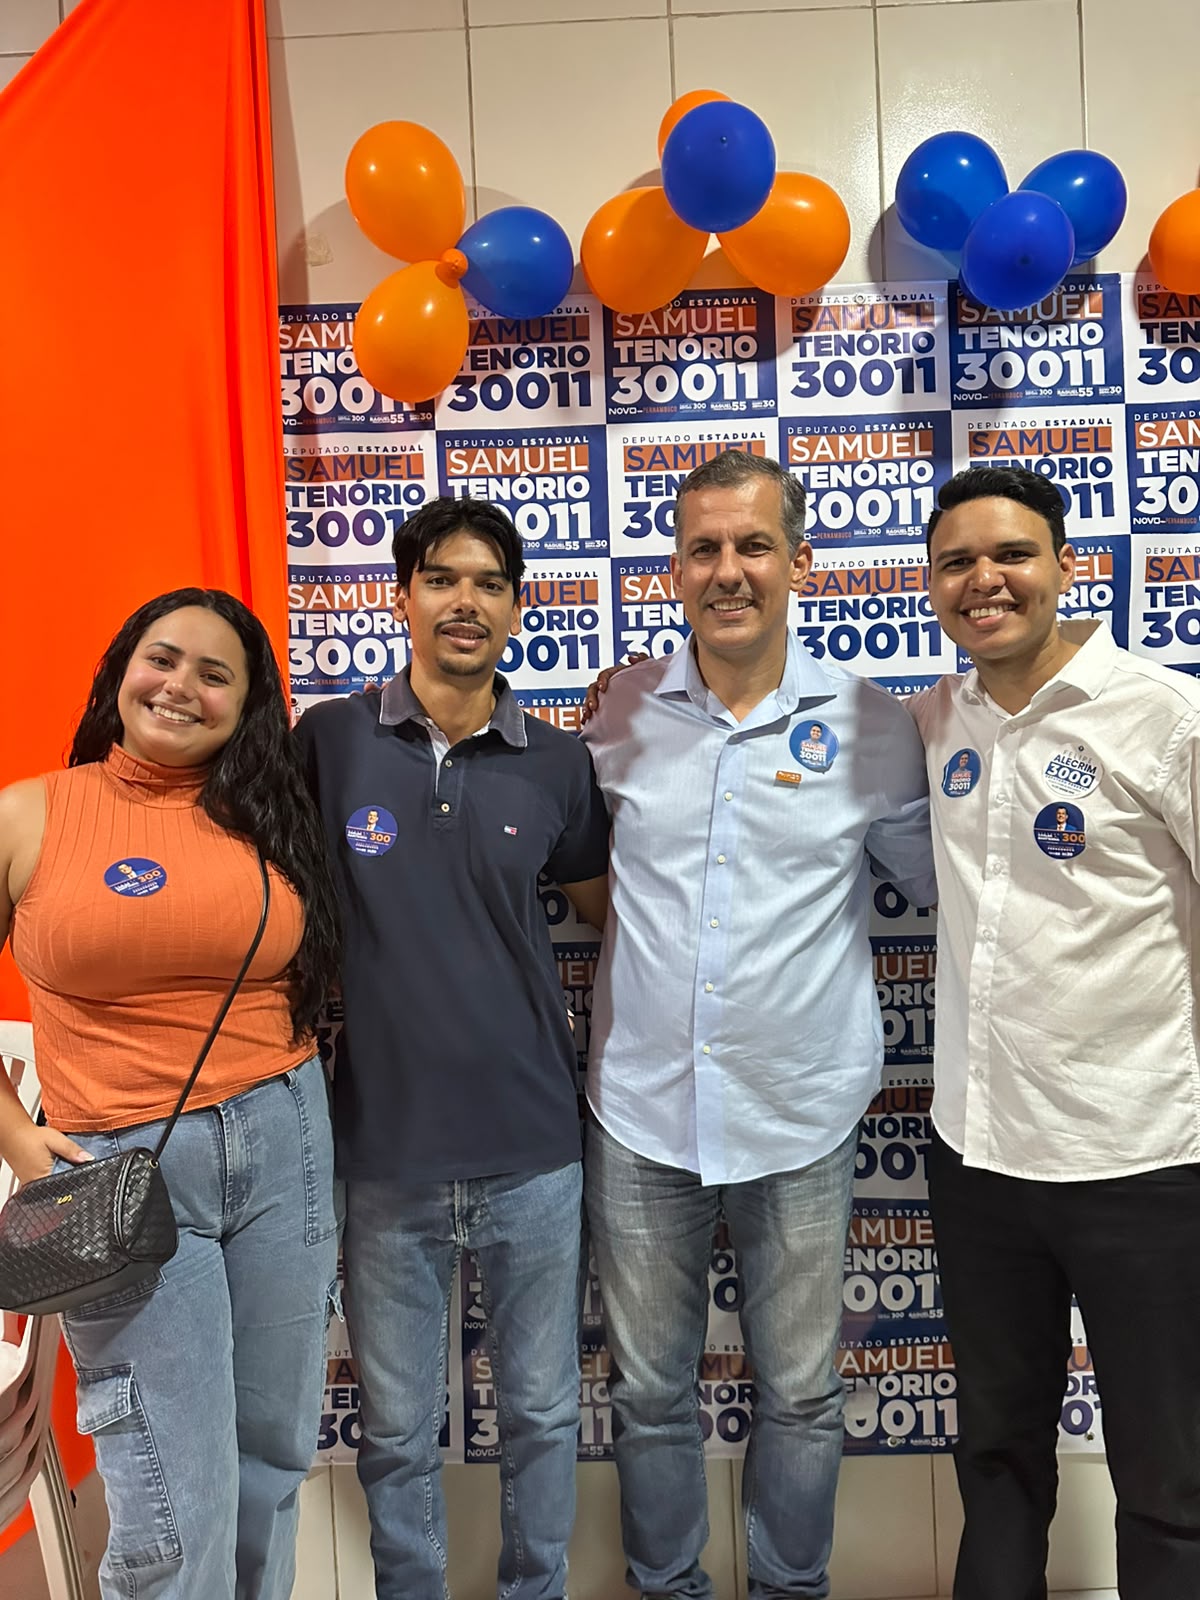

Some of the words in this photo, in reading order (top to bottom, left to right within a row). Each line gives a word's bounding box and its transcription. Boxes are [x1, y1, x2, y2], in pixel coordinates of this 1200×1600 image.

[689, 297, 757, 307] ESTADUAL
[867, 293, 935, 303] ESTADUAL
[280, 313, 338, 322] EPUTADO
[616, 306, 757, 337] SAMUEL
[795, 303, 936, 333] SAMUEL
[472, 316, 589, 344] AMUEL
[958, 319, 1105, 350] TENÓRIO
[613, 332, 758, 364] TENÓRIO
[792, 328, 936, 359] TENÓRIO
[280, 345, 358, 375] TENÓ
[460, 341, 591, 372] ENÓRIO
[790, 356, 937, 399] 30011
[955, 347, 1106, 392] 30011
[447, 370, 592, 412] 30011
[610, 361, 759, 405] 30011
[1039, 388, 1053, 396] 300
[1078, 387, 1094, 397] 55
[1109, 385, 1122, 394] 30
[281, 376, 416, 416] 300
[693, 402, 707, 410] 300
[732, 401, 747, 411] 55
[762, 399, 776, 408] 30
[390, 413, 405, 424] 55
[419, 412, 433, 421] 30
[967, 420, 1037, 430] DEPUTADO
[1045, 418, 1113, 427] ESTADUAL
[1134, 410, 1197, 421] DEPUTAD
[622, 434, 691, 444] DEPUTADO
[698, 431, 766, 441] ESTADUAL
[787, 425, 857, 435] DEPUTADO
[864, 421, 934, 432] ESTADUAL
[357, 444, 424, 453] ESTADUAL
[445, 438, 515, 448] DEPUTADO
[522, 436, 590, 446] ESTADUAL
[791, 431, 933, 462] SAMUEL
[972, 427, 1112, 456] SAMUEL
[287, 454, 424, 482] SAMUEL
[449, 446, 589, 475] SAMUEL
[789, 457, 935, 489] TENÓRIO
[285, 478, 426, 508] TENÓRIO
[447, 471, 591, 501] TENÓRIO
[286, 508, 421, 548] 3001
[867, 527, 882, 535] 300
[907, 526, 923, 536] 55
[527, 541, 541, 549] 300
[565, 541, 580, 550] 55
[595, 539, 608, 548] 30
[1145, 546, 1200, 555] DEPUTAD
[533, 571, 599, 580] ESTADUAL
[620, 565, 669, 575] DEPUTA
[814, 560, 866, 569] PUTADO
[291, 574, 352, 583] EPUTADO
[358, 573, 398, 582] ESTAD
[288, 582, 397, 609] SAMUE
[523, 605, 600, 633] ÓRIO
[495, 633, 601, 673] 0011
[797, 620, 942, 662] 30011
[288, 637, 412, 676] 3001
[365, 675, 379, 683] 300
[1046, 761, 1093, 788] 3000
[1053, 754, 1097, 775] ALECRIM
[948, 782, 971, 791] 30011
[369, 832, 391, 843] 300
[1062, 832, 1086, 843] 300
[137, 870, 161, 883] 300
[842, 1273, 941, 1313] 001
[928, 1309, 944, 1319] 55
[839, 1340, 883, 1349] UTADO
[890, 1335, 949, 1346] ESTADUA
[839, 1345, 956, 1374] AMUEL
[589, 1445, 605, 1456] 55
[931, 1437, 946, 1447] 55
